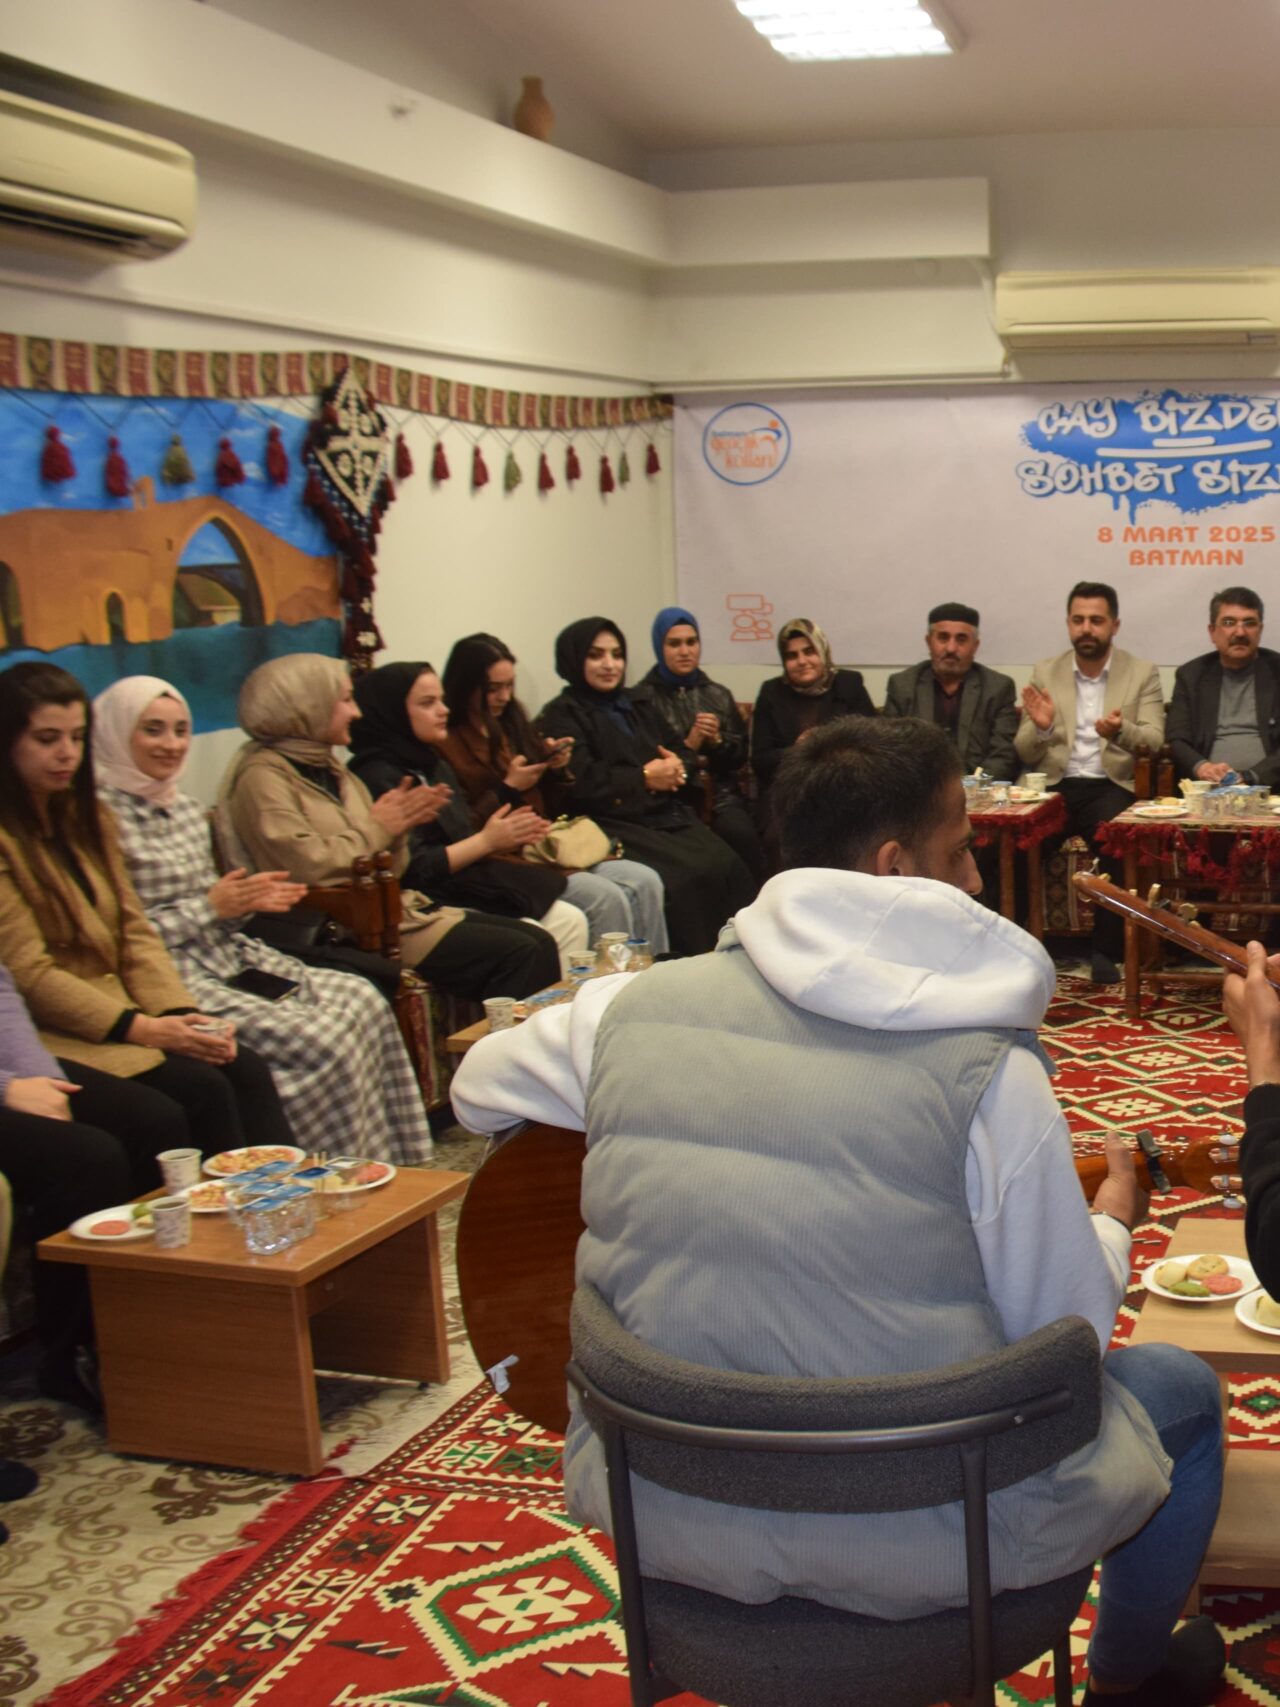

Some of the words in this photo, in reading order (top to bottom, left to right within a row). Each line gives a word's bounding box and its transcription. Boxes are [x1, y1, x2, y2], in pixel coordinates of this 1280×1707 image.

[1015, 459, 1183, 497] SOHBET
[1097, 526, 1113, 543] 8
[1122, 526, 1199, 543] MART
[1208, 526, 1276, 543] 2025
[1129, 549, 1245, 567] BATMAN
